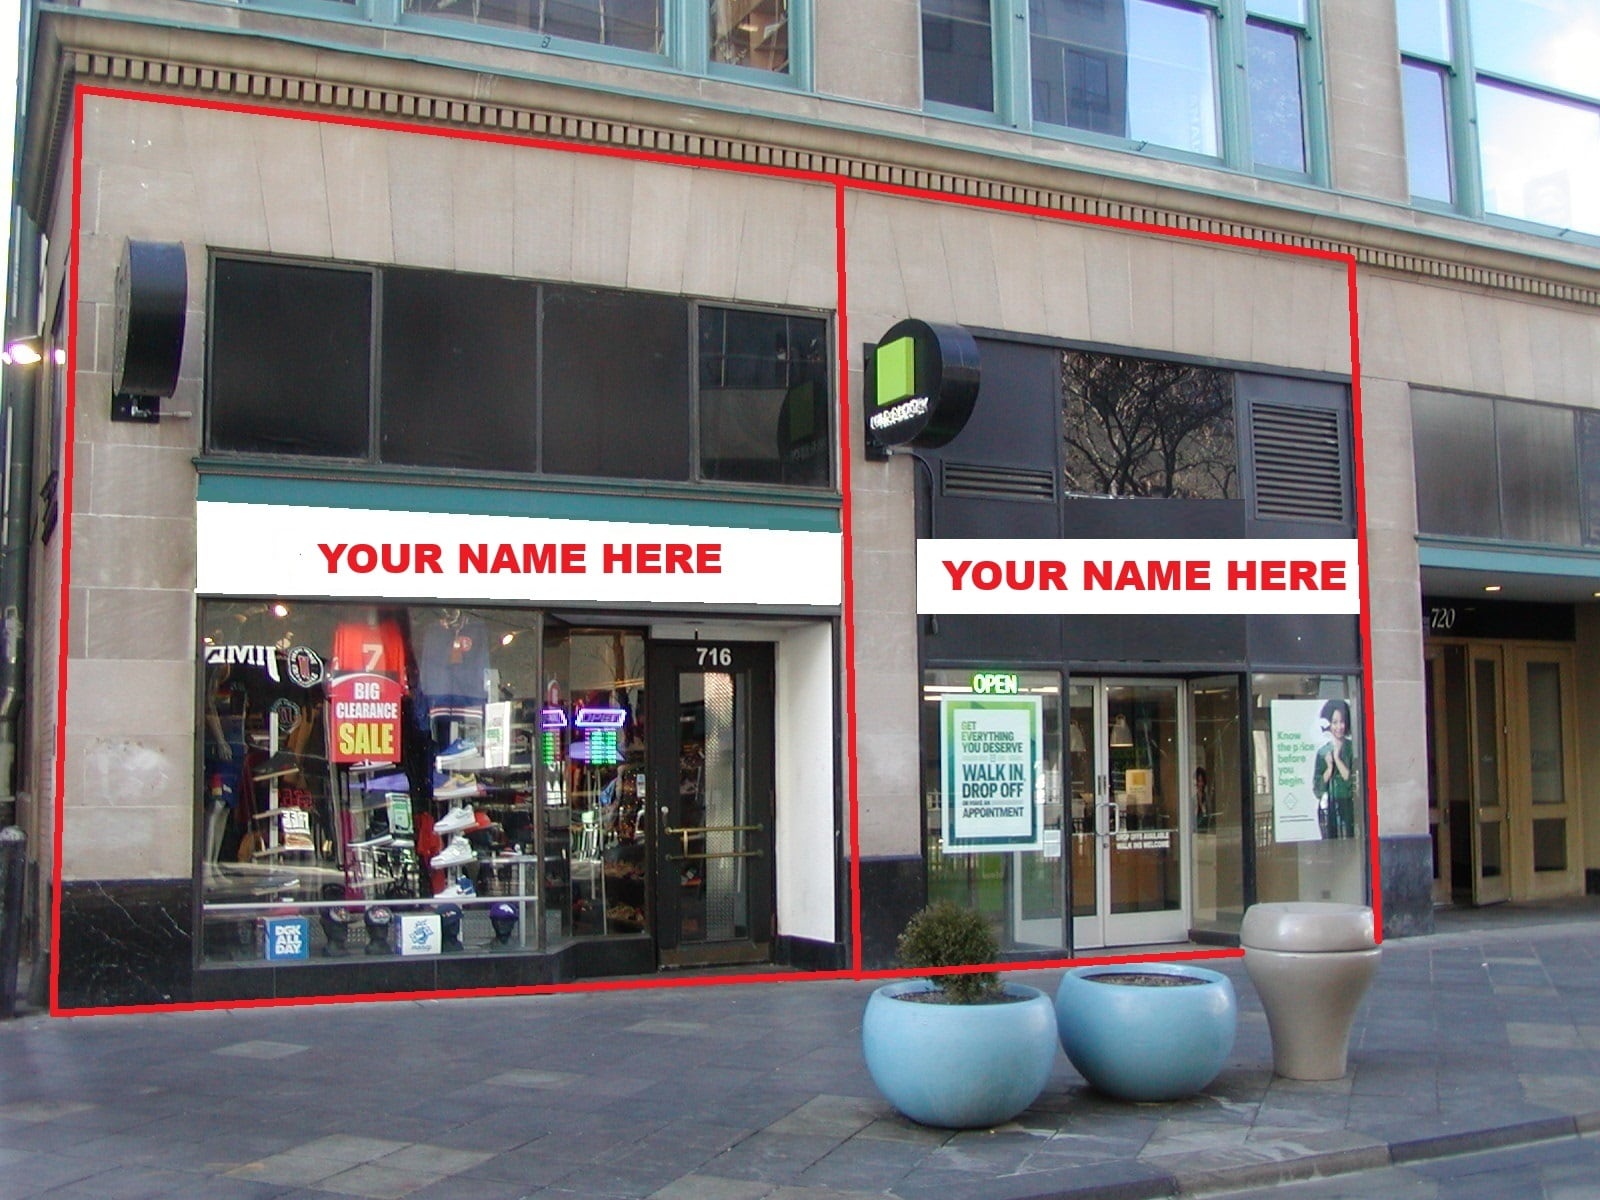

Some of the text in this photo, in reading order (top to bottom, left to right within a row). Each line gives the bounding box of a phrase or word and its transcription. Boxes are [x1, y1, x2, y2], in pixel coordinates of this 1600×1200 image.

[1431, 607, 1456, 629] 720
[362, 643, 384, 673] 7
[696, 647, 732, 666] 716
[973, 673, 1018, 694] OPEN
[354, 682, 381, 700] BIG
[336, 702, 398, 719] CLEARANCE
[961, 721, 977, 731] GET
[339, 722, 395, 755] SALE
[961, 731, 1014, 742] EVERYTHING
[1277, 731, 1302, 740] Know
[962, 742, 1024, 753] YOU DESERVE
[1277, 742, 1291, 752] the
[1278, 755, 1306, 764] before
[962, 763, 1006, 782] WALK
[1278, 766, 1294, 776] you
[962, 782, 1025, 799] DROP OFF
[962, 806, 1025, 818] APPOINTMENT
[275, 925, 302, 936] DGK
[275, 934, 303, 944] ALL
